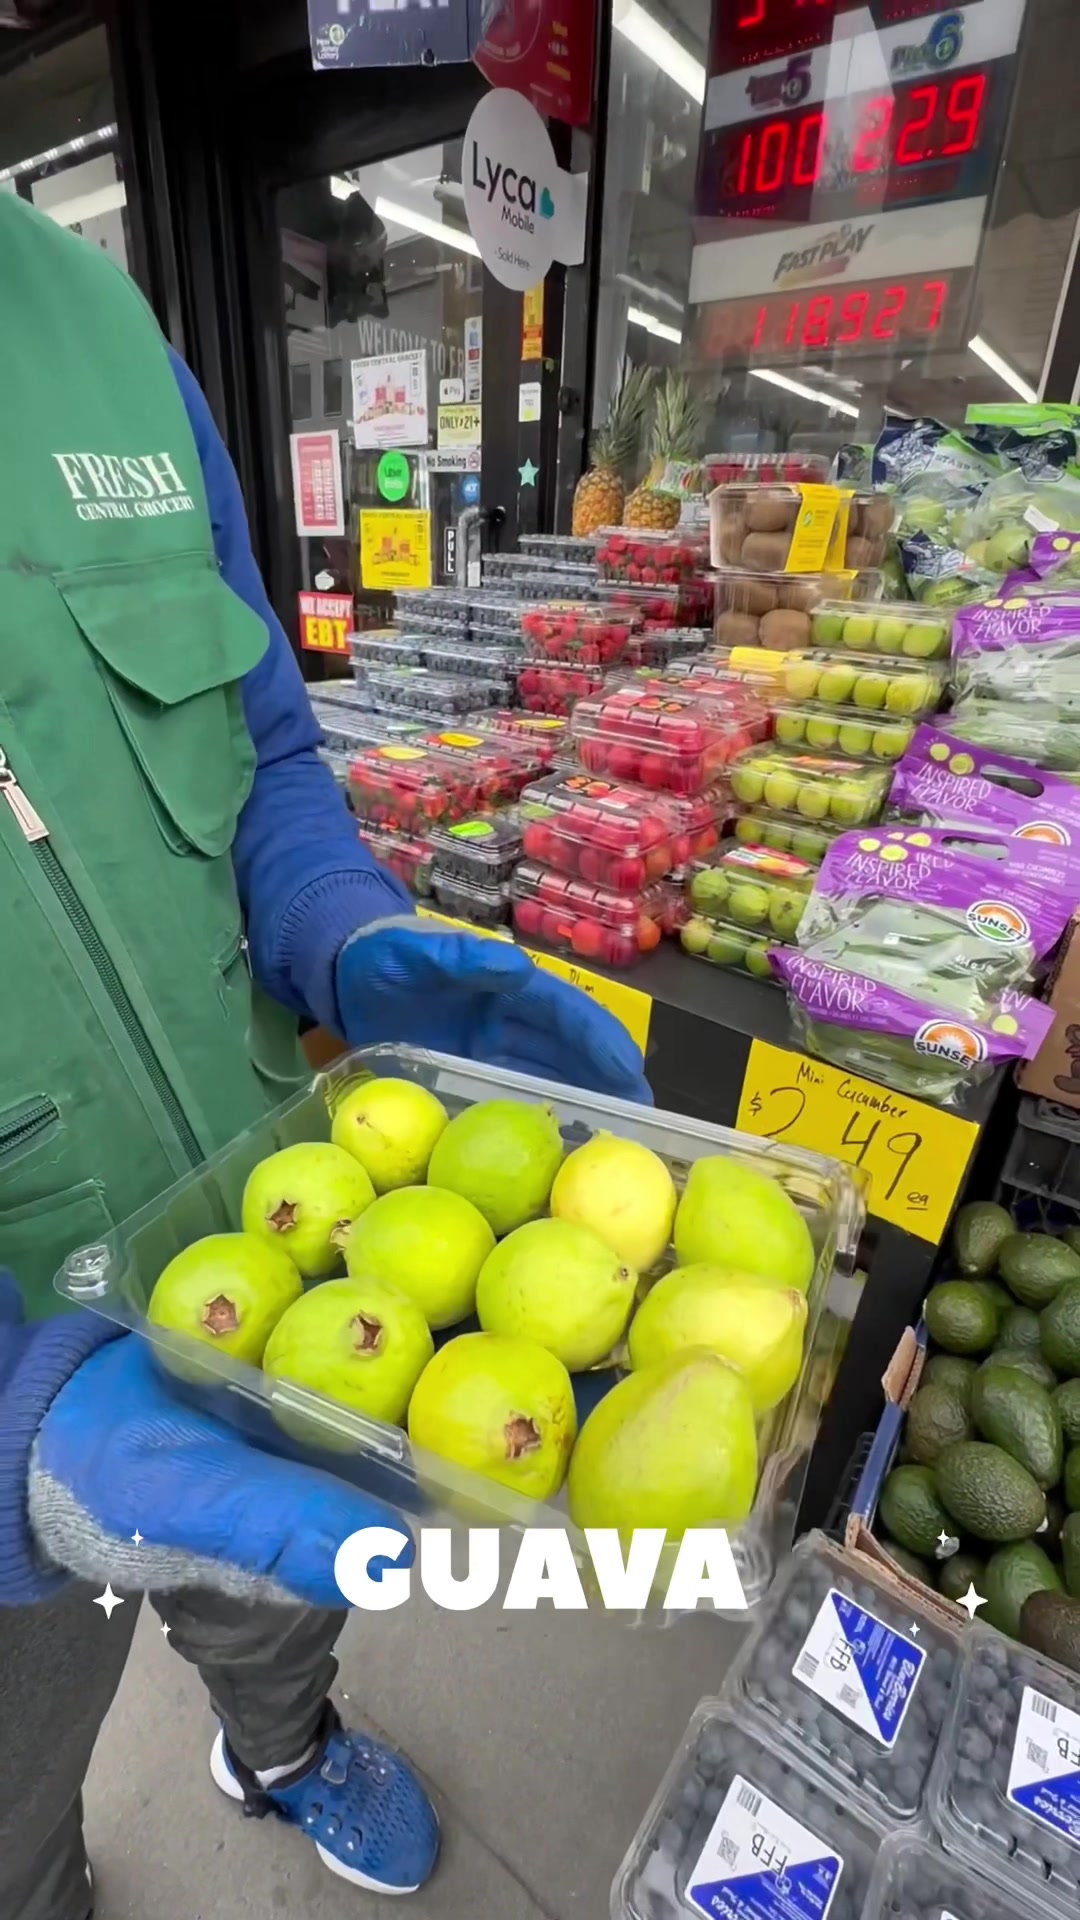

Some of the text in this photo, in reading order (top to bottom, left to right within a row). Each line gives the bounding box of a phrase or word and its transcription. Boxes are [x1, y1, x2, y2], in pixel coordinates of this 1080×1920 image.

[737, 112, 829, 194] 100
[472, 140, 536, 214] Lyca
[501, 204, 535, 235] Mobile
[440, 415, 460, 431] ONLY
[52, 452, 187, 499] FRESH
[437, 455, 467, 469] Smoking
[76, 496, 195, 521] CENTRAL GROCERY
[447, 530, 455, 572] PULL
[972, 606, 1051, 621] INSPIRED
[974, 618, 1042, 638] FLAVOR
[305, 615, 347, 650] EBT
[915, 762, 992, 799] INSPIRED
[911, 783, 977, 813] FLAVOR
[845, 870, 920, 892] FLAVOR
[846, 852, 931, 879] INSPIRED
[967, 911, 1026, 942] SUNSET
[791, 973, 864, 1013] FLAVOR
[796, 1061, 825, 1084] Mini
[836, 1078, 908, 1119] Cucumber
[752, 1833, 788, 1877] FFB
